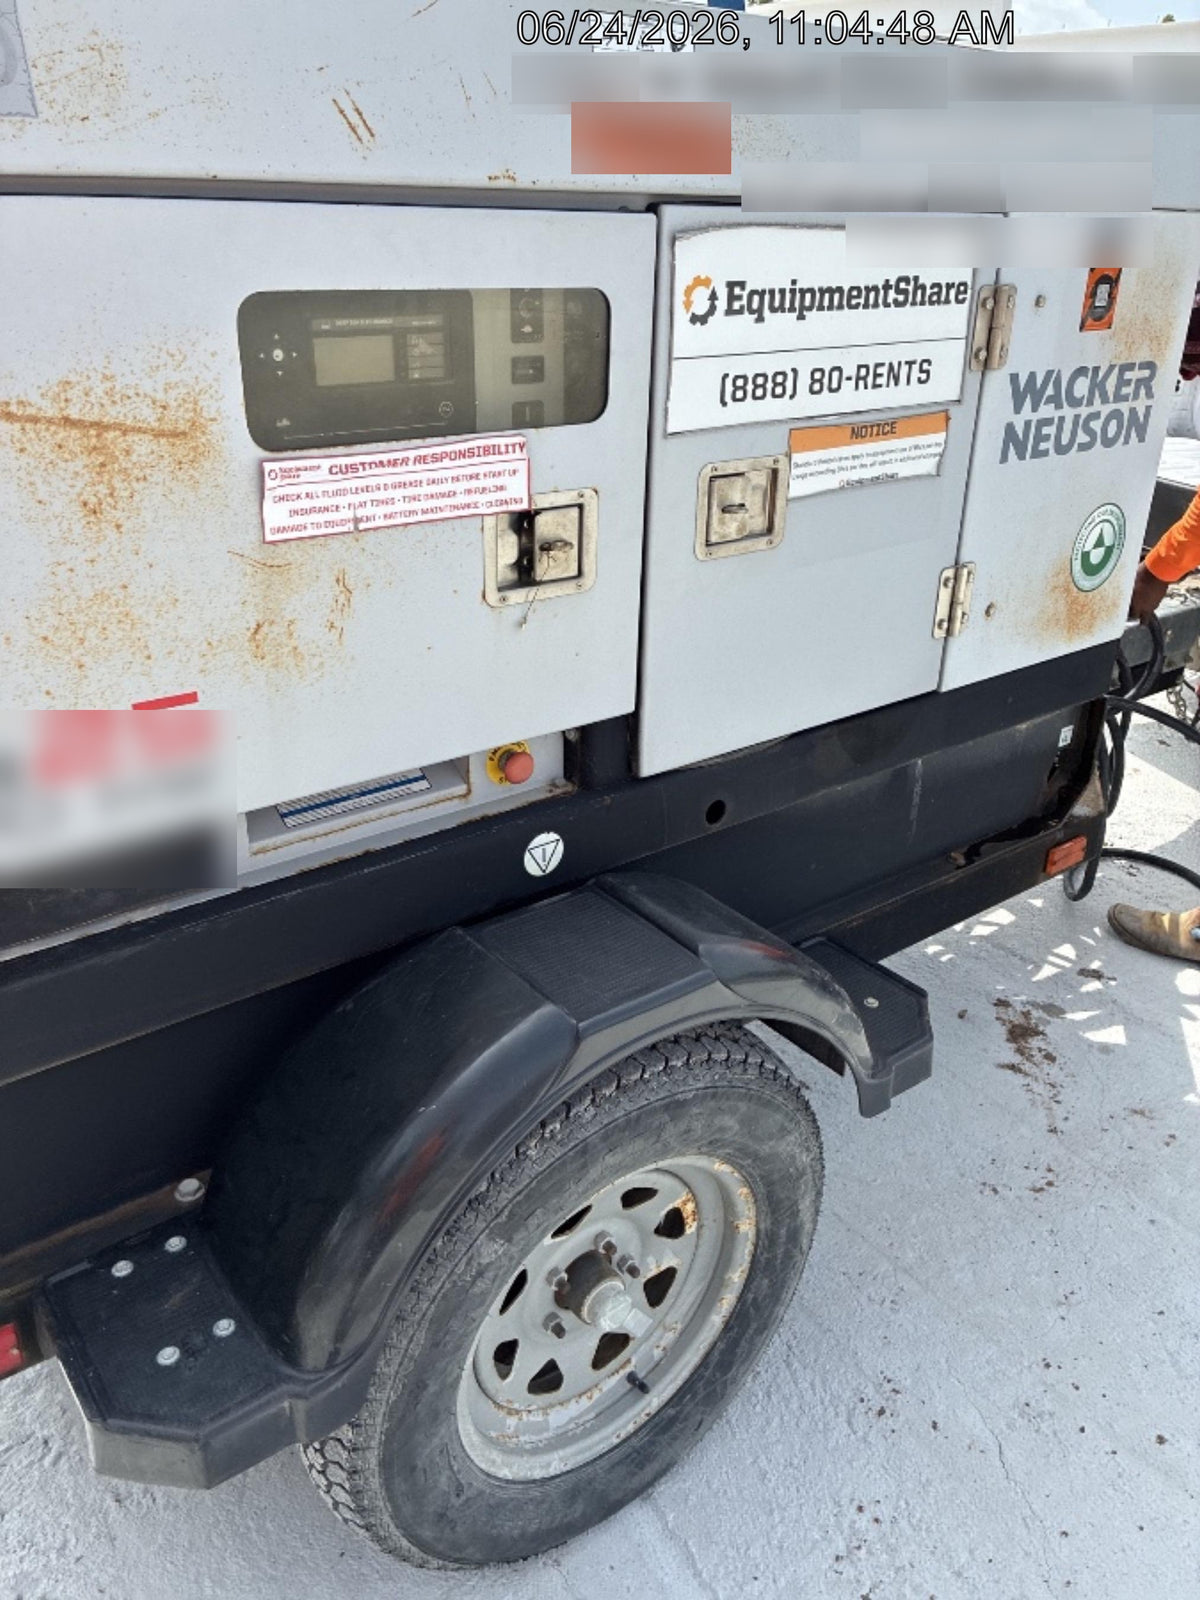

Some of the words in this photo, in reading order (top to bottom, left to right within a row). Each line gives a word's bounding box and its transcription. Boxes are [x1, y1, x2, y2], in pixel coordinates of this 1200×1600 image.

[724, 276, 969, 321] EquipmentShare
[719, 370, 798, 406] (888)
[808, 358, 932, 396] 80-RENTS
[1008, 360, 1158, 415] WACKER
[850, 421, 898, 440] NOTICE
[999, 405, 1153, 465] NEUSON
[328, 456, 410, 476] CUSTOMER
[413, 441, 527, 466] RESPONSIBILITY
[289, 503, 341, 518] INSURANCE
